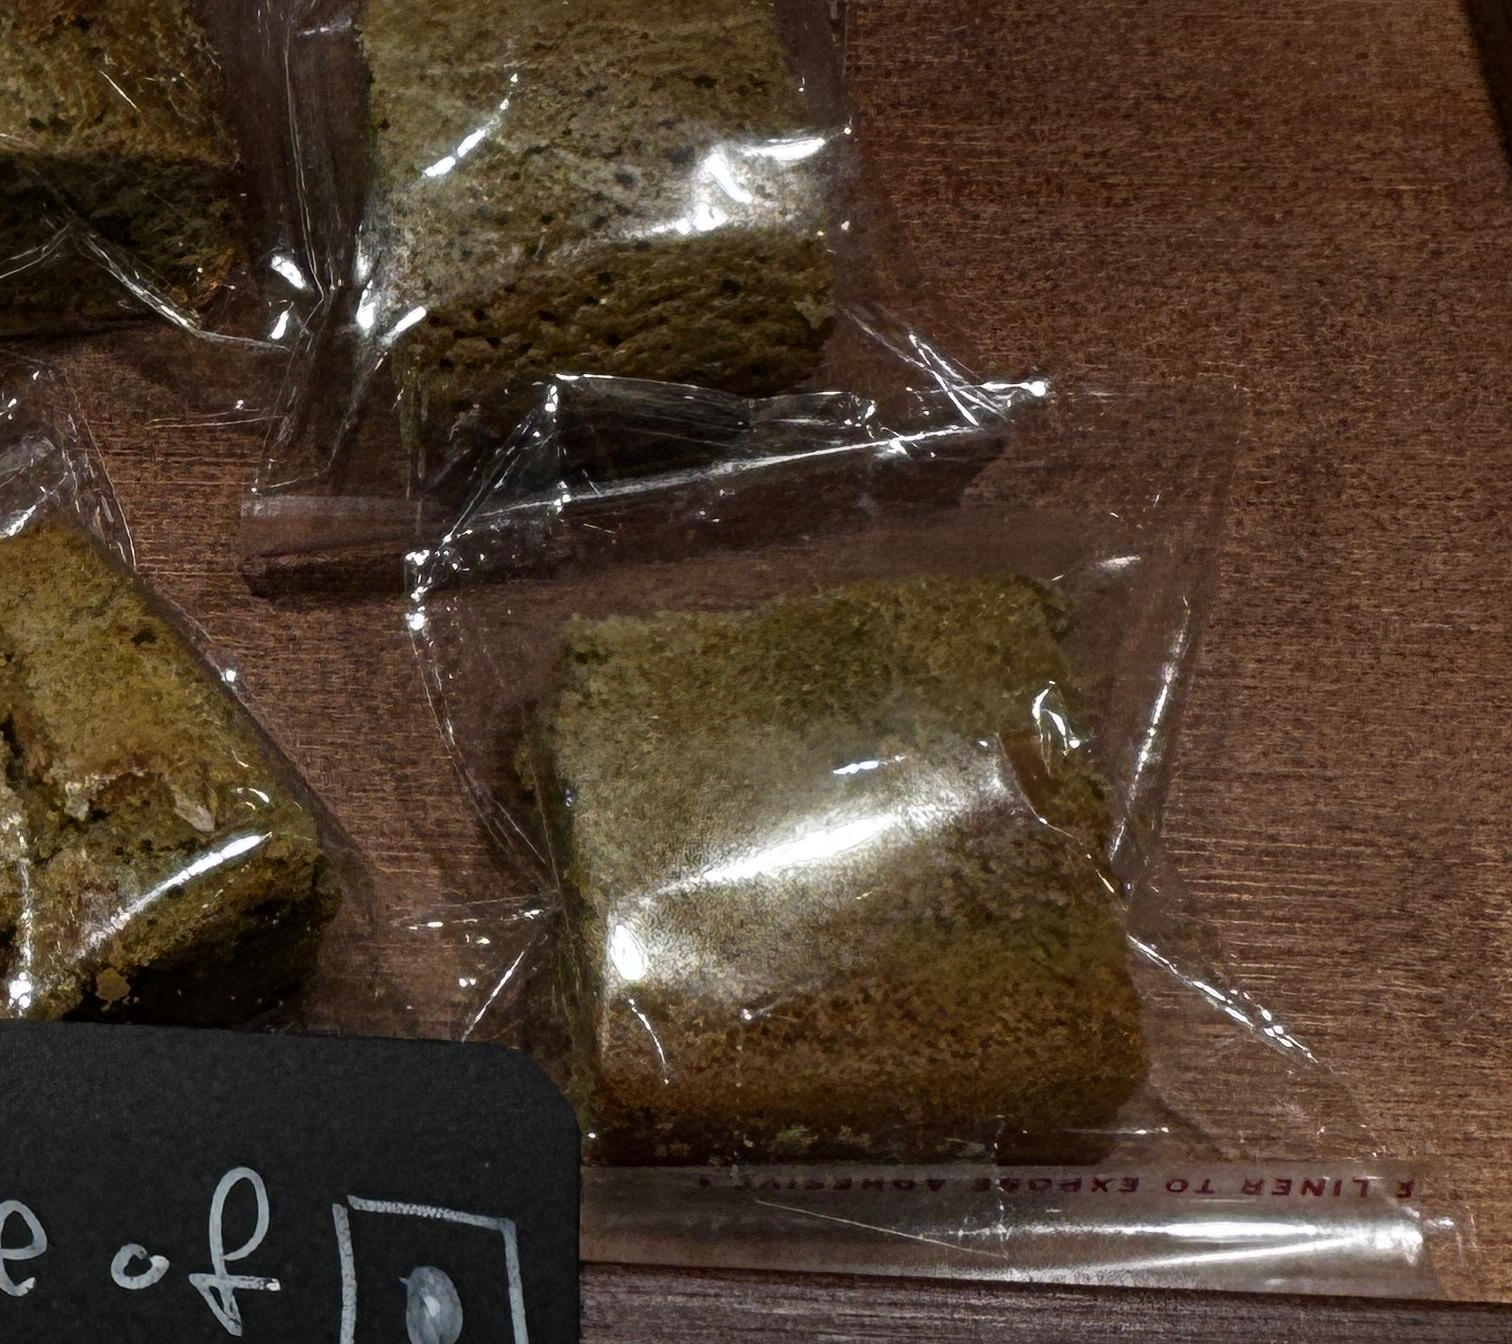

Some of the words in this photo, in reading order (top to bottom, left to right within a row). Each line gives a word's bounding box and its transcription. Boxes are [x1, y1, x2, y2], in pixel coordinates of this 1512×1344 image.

[1165, 1178, 1216, 1195] TO
[1241, 1177, 1372, 1199] LINER
[109, 1164, 282, 1338] of
